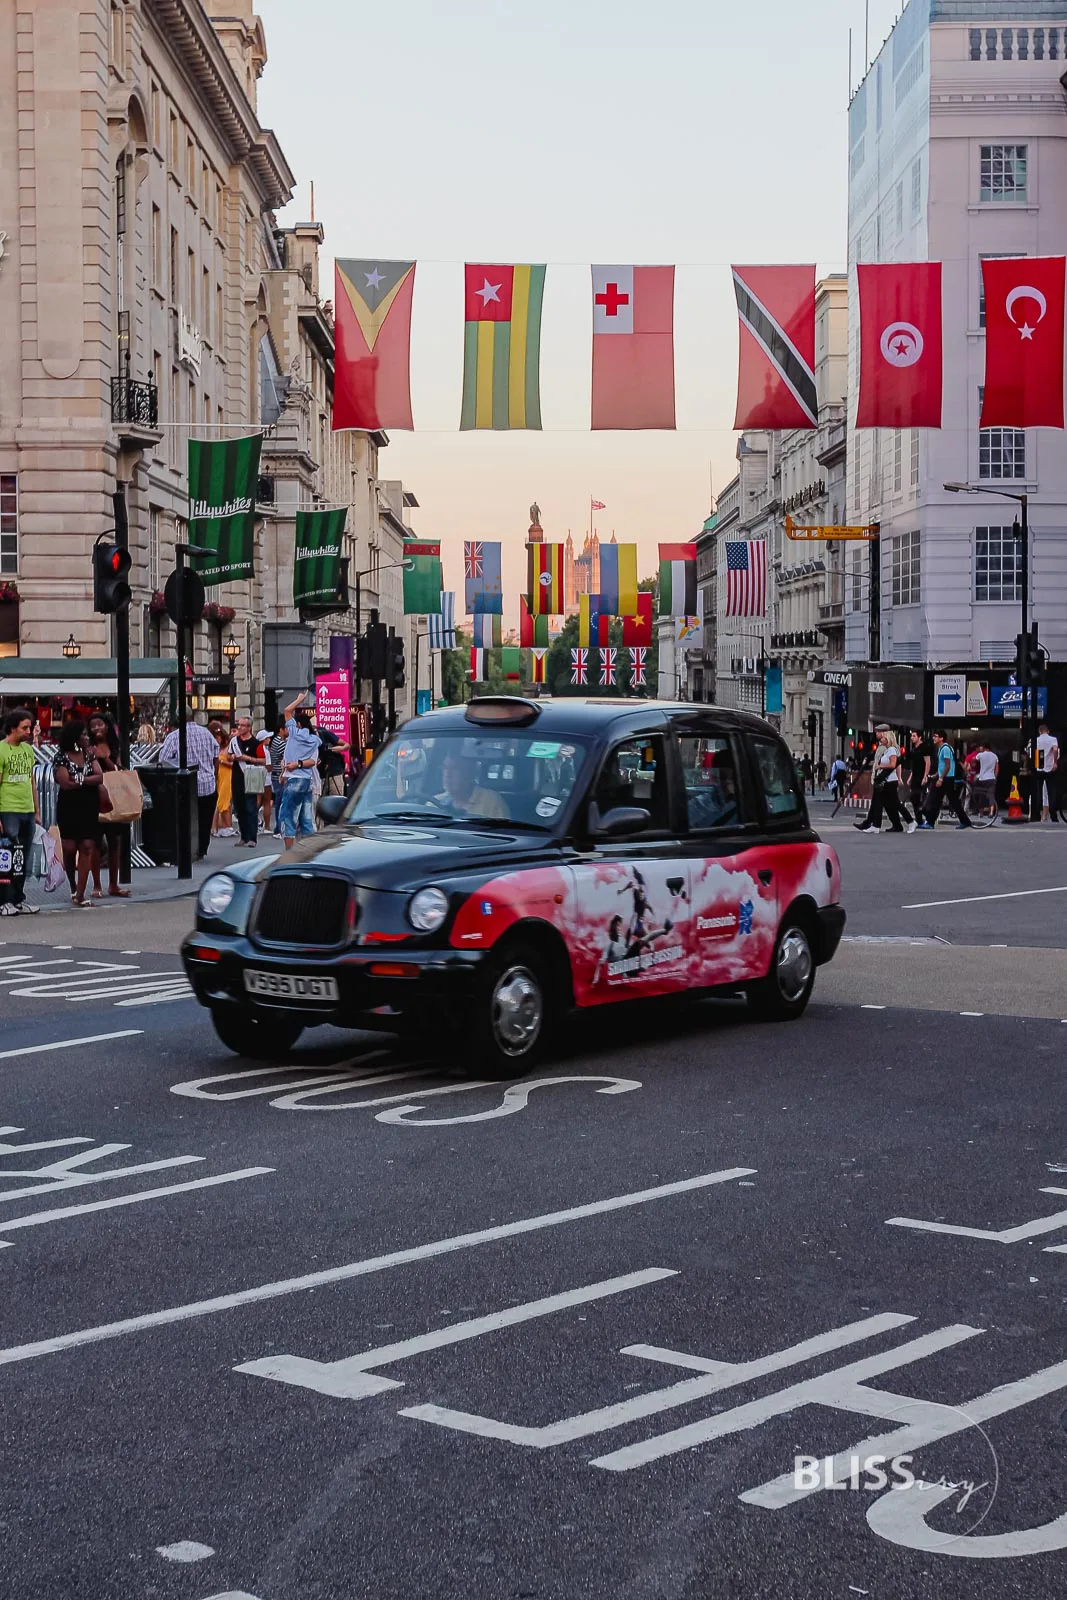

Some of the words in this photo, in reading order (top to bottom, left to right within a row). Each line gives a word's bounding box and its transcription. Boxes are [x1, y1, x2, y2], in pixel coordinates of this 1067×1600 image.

[189, 496, 252, 520] Lillywhites
[296, 544, 339, 561] Lillywhites
[220, 564, 231, 572] TO
[230, 562, 252, 570] SPORT
[319, 714, 345, 722] Parade
[697, 913, 736, 929] Panasonic
